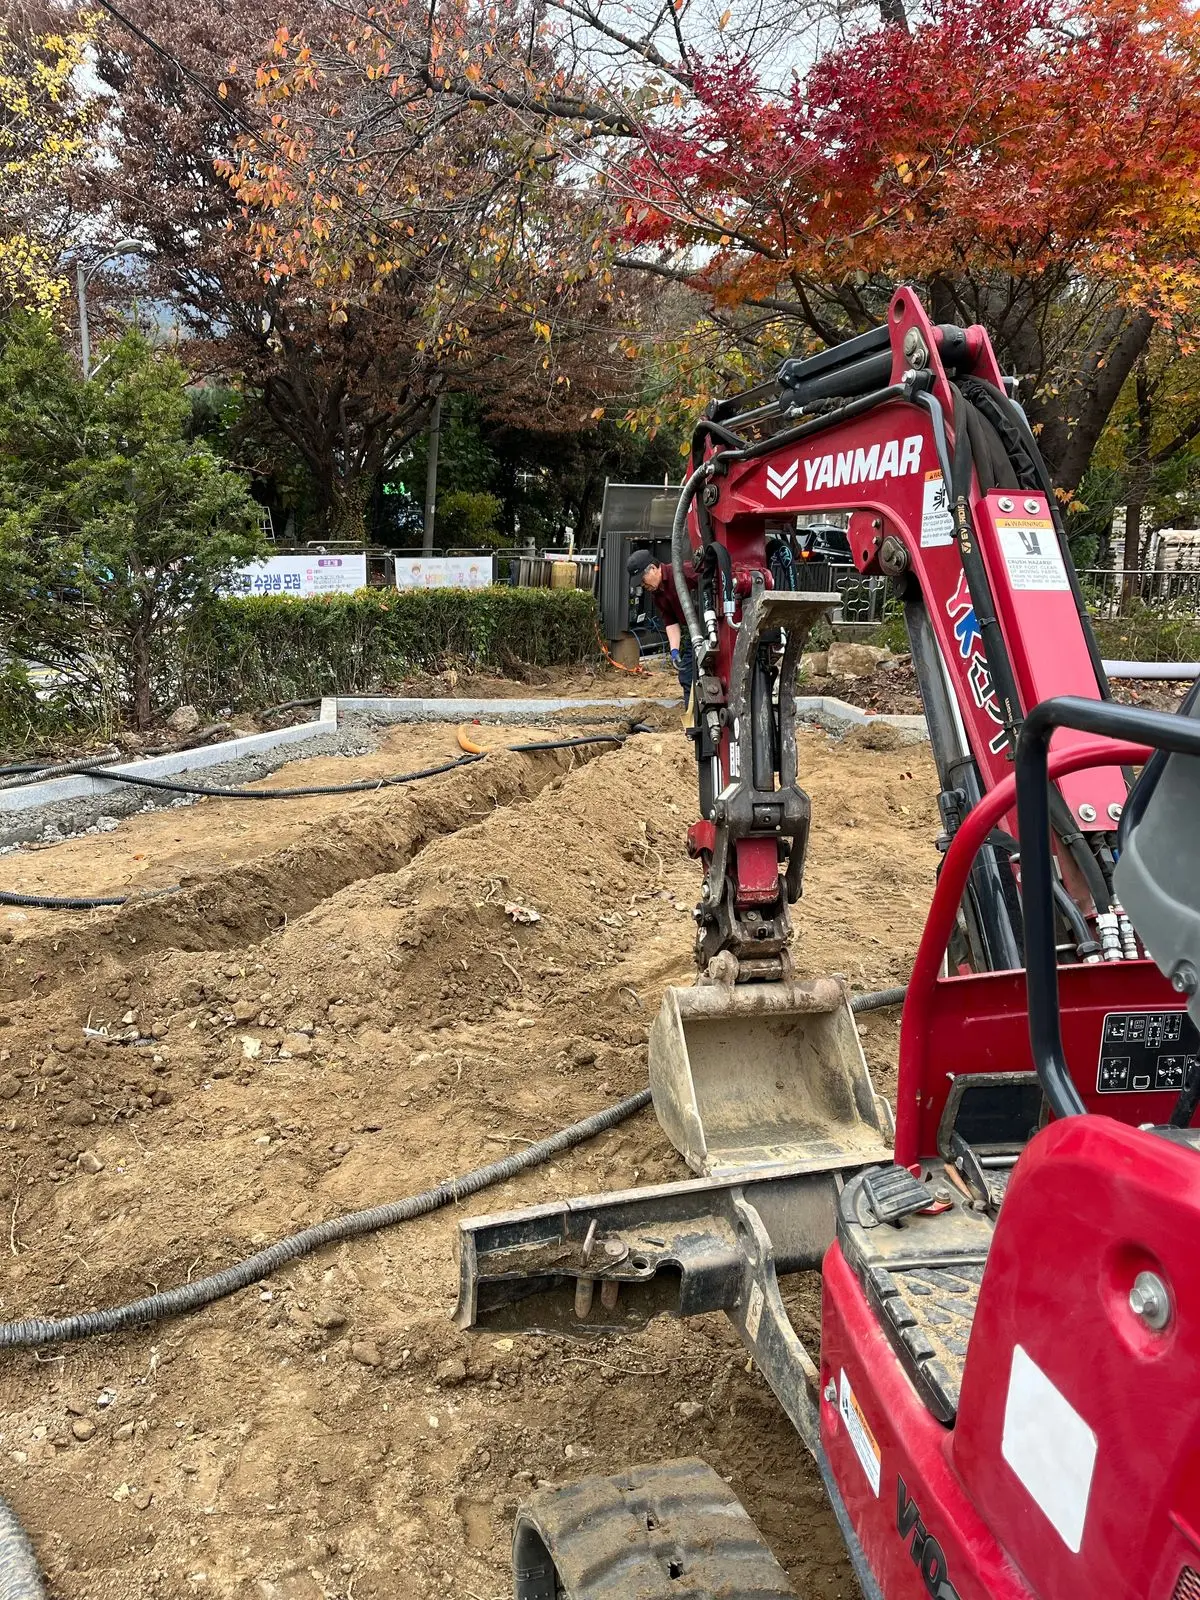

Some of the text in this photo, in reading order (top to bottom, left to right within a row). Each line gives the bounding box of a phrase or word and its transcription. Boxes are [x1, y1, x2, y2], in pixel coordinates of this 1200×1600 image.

[804, 434, 924, 492] YANMAR
[254, 574, 281, 591] 수강생
[284, 573, 301, 590] 모집
